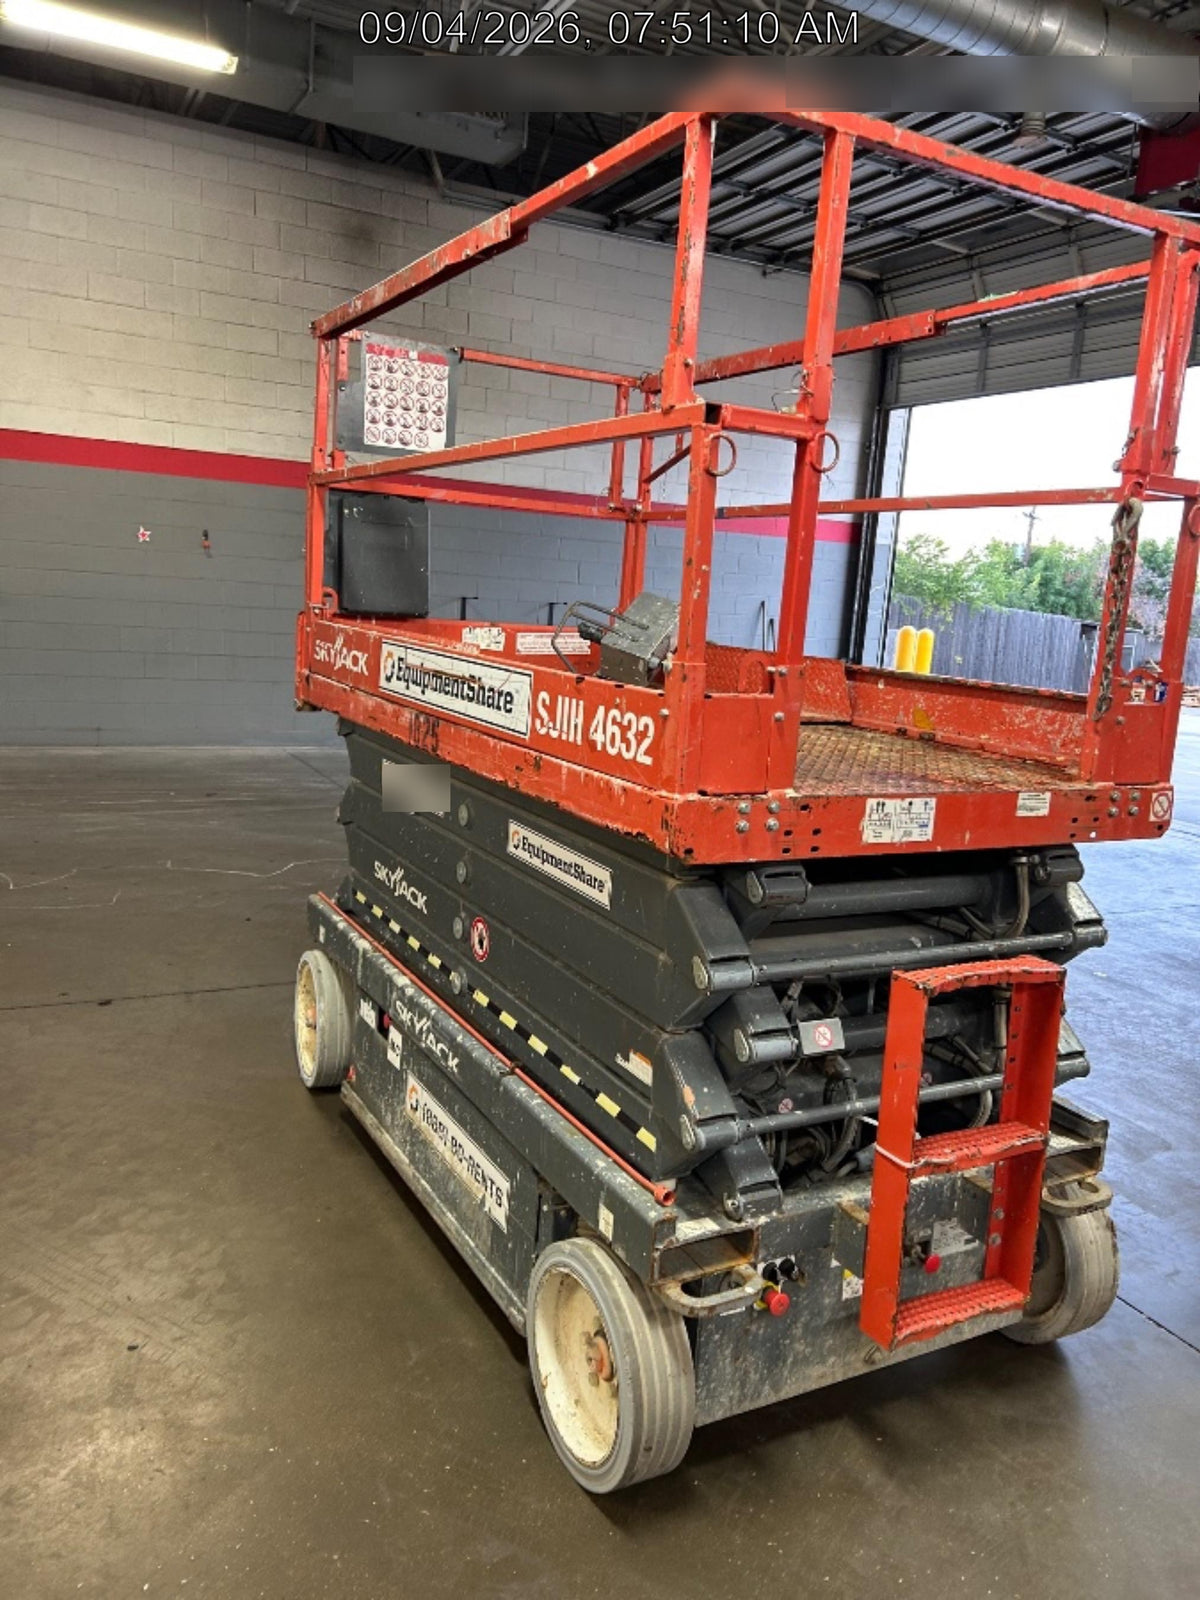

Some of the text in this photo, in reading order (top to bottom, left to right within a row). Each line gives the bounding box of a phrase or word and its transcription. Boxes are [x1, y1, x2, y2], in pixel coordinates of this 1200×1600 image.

[313, 632, 369, 676] SKYJACK
[396, 656, 514, 714] EquipmentShare
[589, 705, 655, 766] 4632
[374, 860, 428, 914] SKYJACK
[522, 835, 606, 893] EquipmentShare
[395, 1000, 460, 1073] SKYJACK
